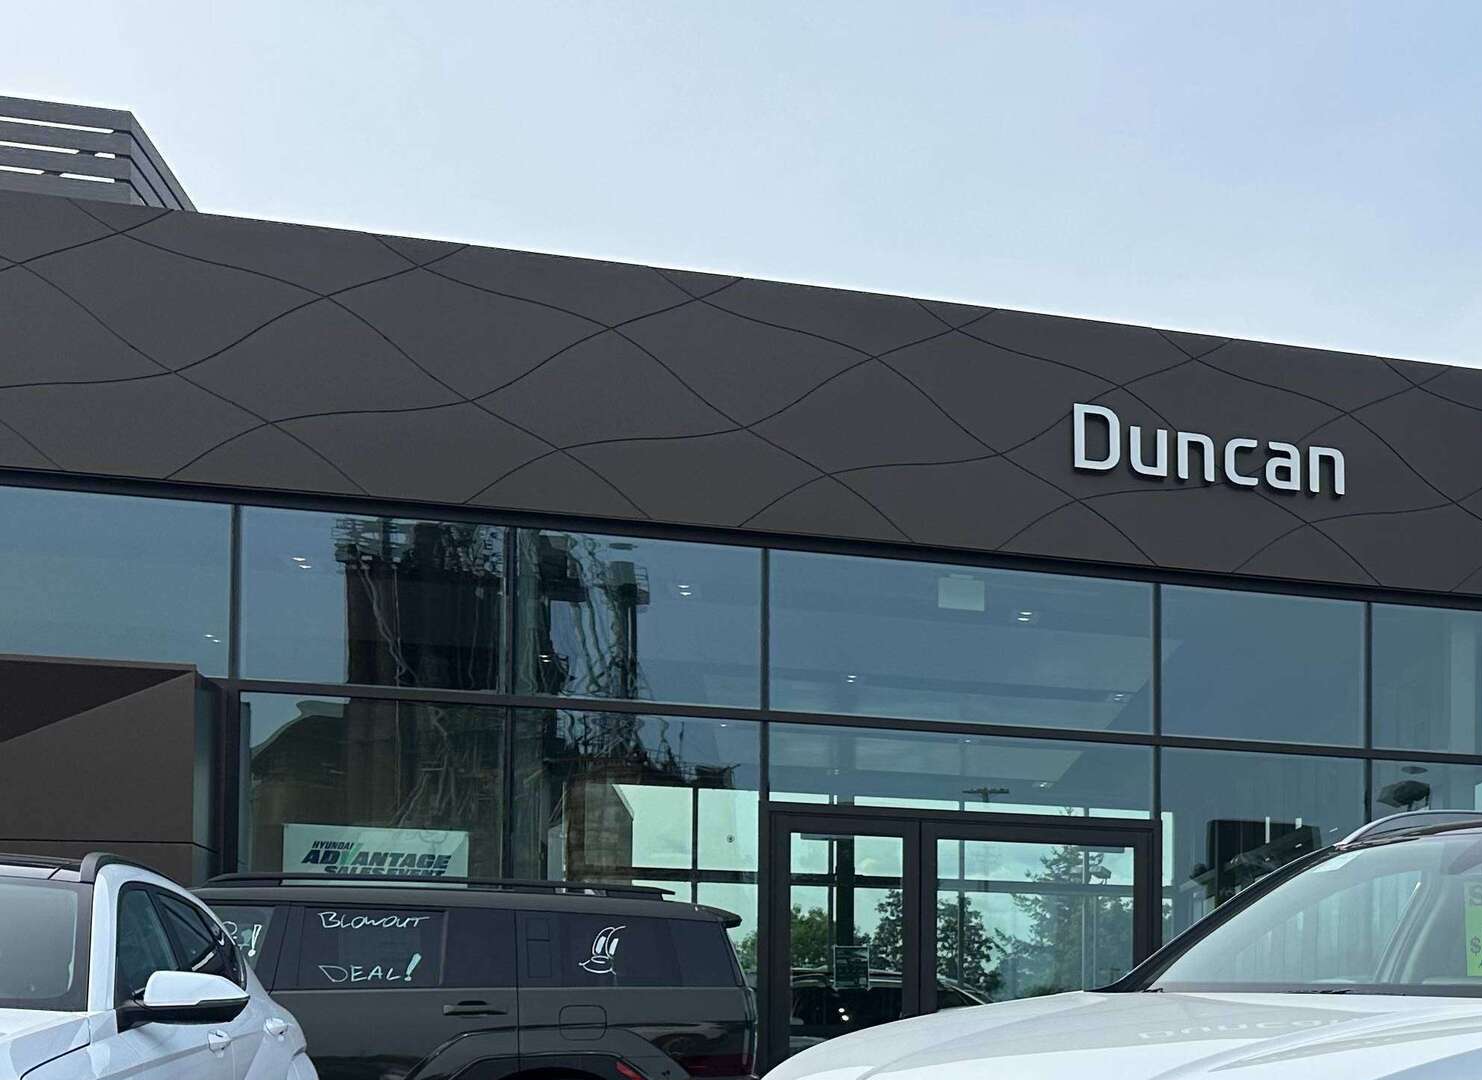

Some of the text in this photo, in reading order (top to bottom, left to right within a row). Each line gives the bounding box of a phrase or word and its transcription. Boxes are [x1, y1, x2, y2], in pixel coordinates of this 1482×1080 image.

[1073, 402, 1345, 496] Duncan
[301, 843, 452, 870] ADVANTAGE
[311, 840, 354, 850] HYUNDAI
[318, 953, 422, 983] DEAL!
